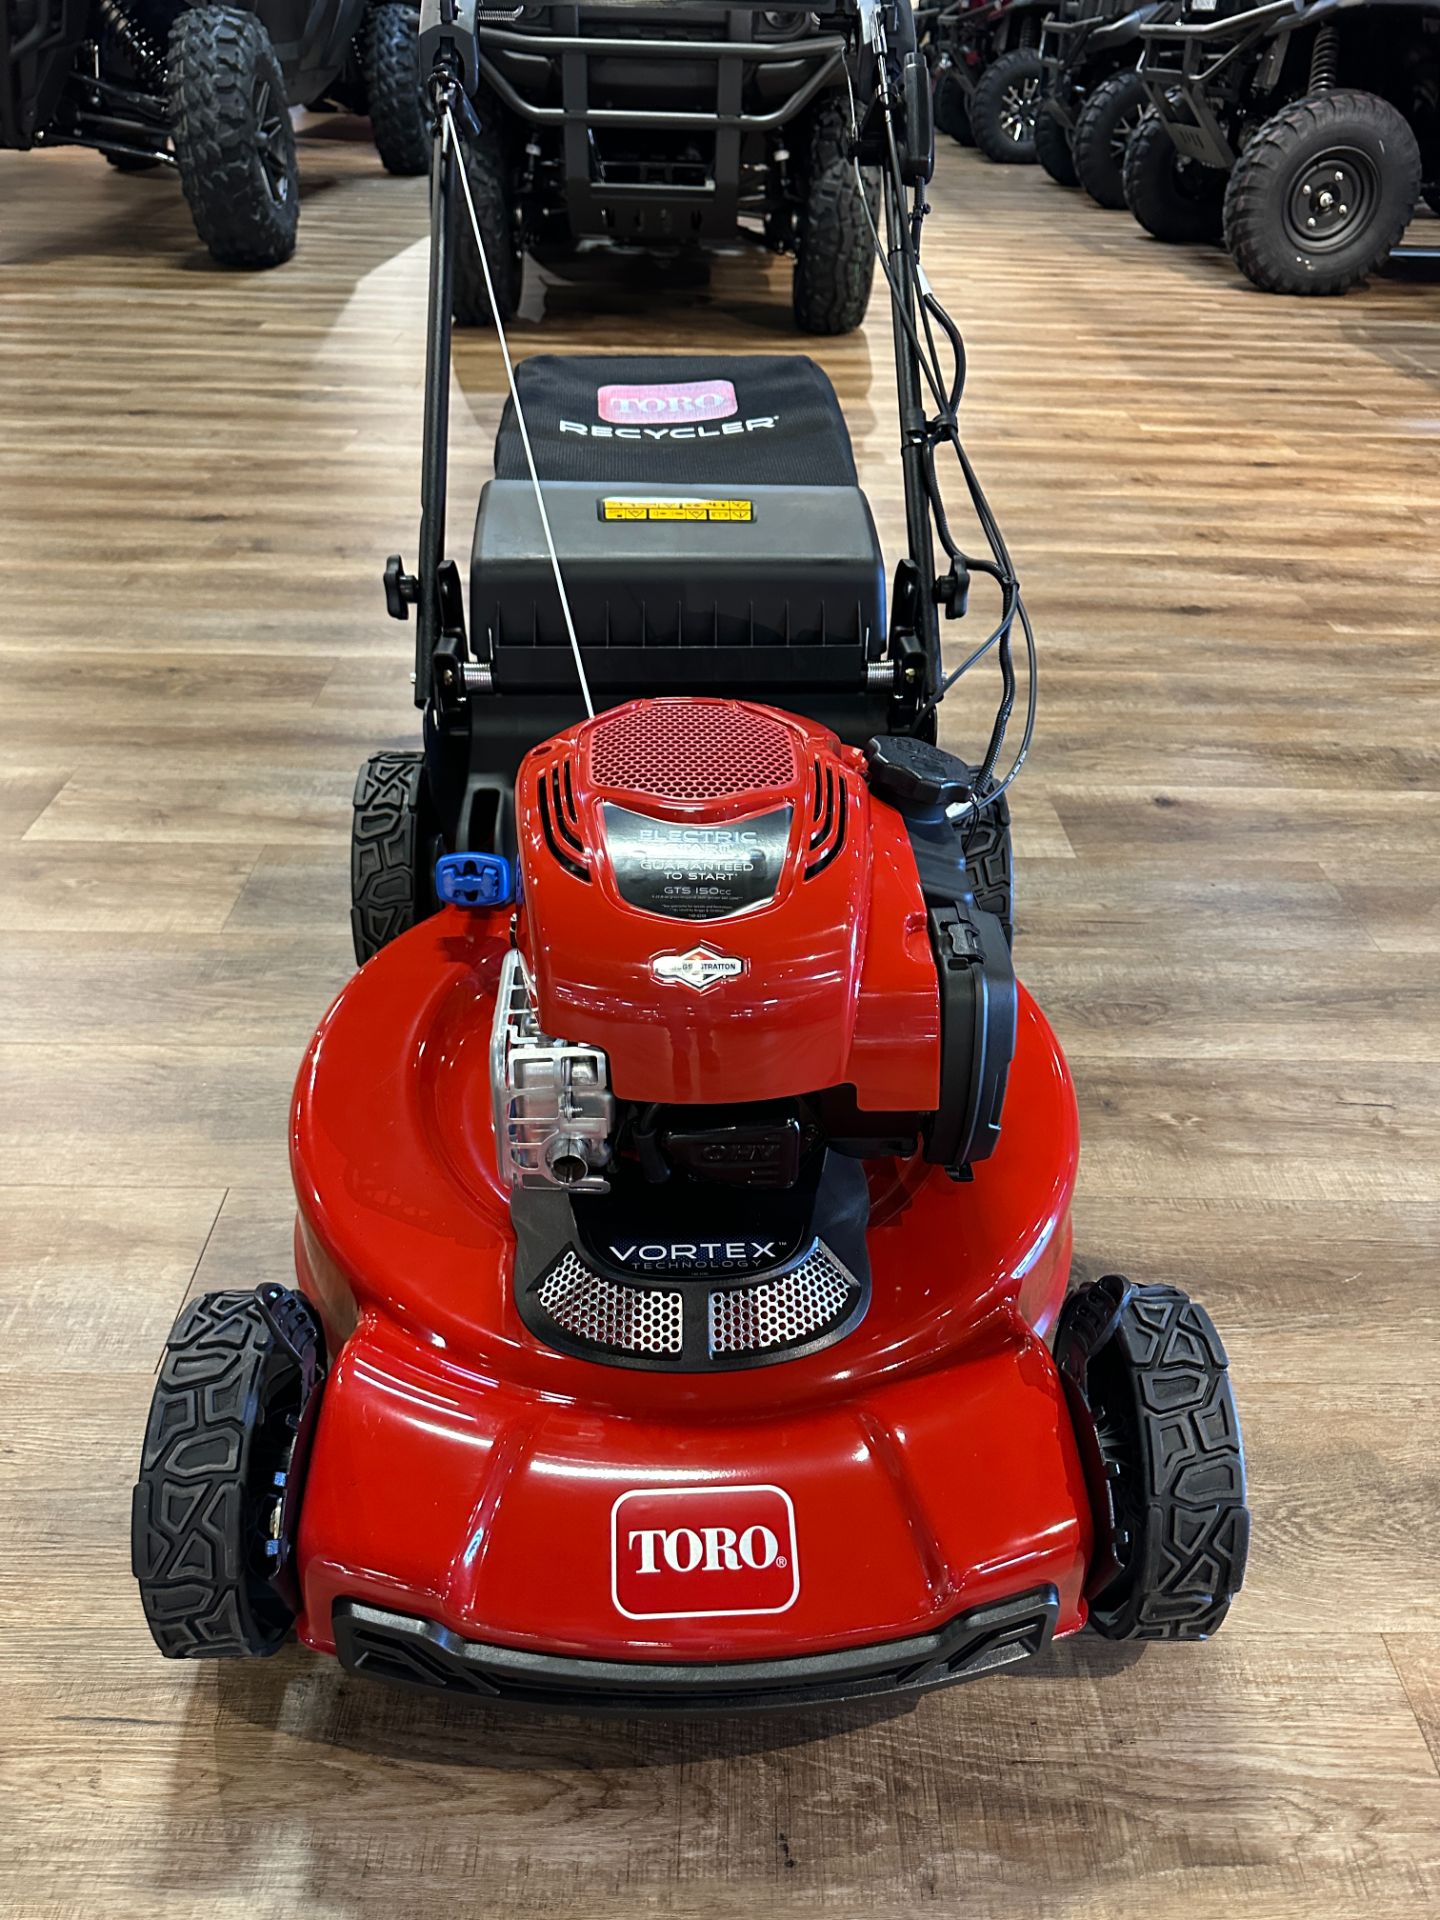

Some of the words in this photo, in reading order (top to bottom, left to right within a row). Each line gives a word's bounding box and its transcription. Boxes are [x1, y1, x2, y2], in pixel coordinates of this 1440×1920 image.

[610, 393, 725, 414] TORO
[559, 415, 777, 440] RECYCLER
[639, 829, 757, 844] ELECTRIC
[640, 860, 754, 872] GUARANTEED
[663, 872, 683, 880] TO
[664, 886, 692, 895] GTS
[632, 1259, 762, 1270] TECHNOLOGY
